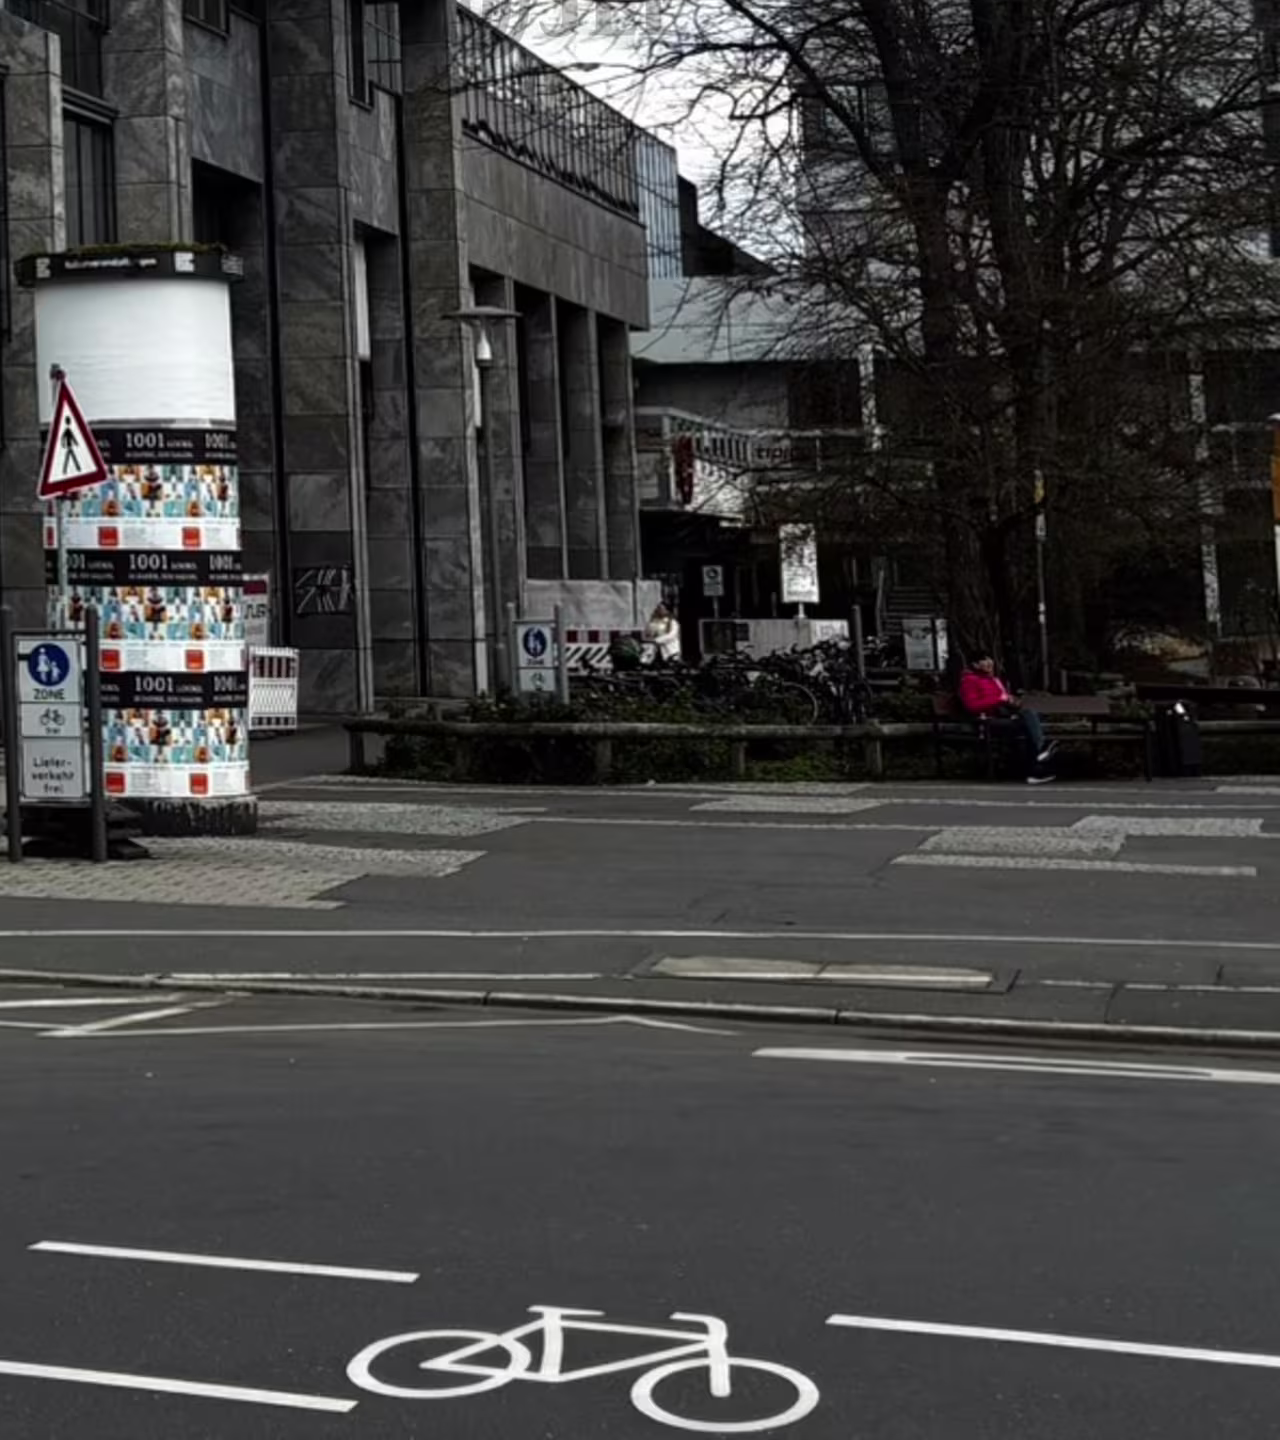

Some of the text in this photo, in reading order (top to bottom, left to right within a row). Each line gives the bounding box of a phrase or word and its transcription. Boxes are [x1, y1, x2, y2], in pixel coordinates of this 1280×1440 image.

[125, 432, 165, 449] 1001
[129, 553, 169, 569] 1001
[134, 676, 173, 692] 1001
[33, 688, 66, 701] ZONE
[32, 771, 75, 782] verkehr
